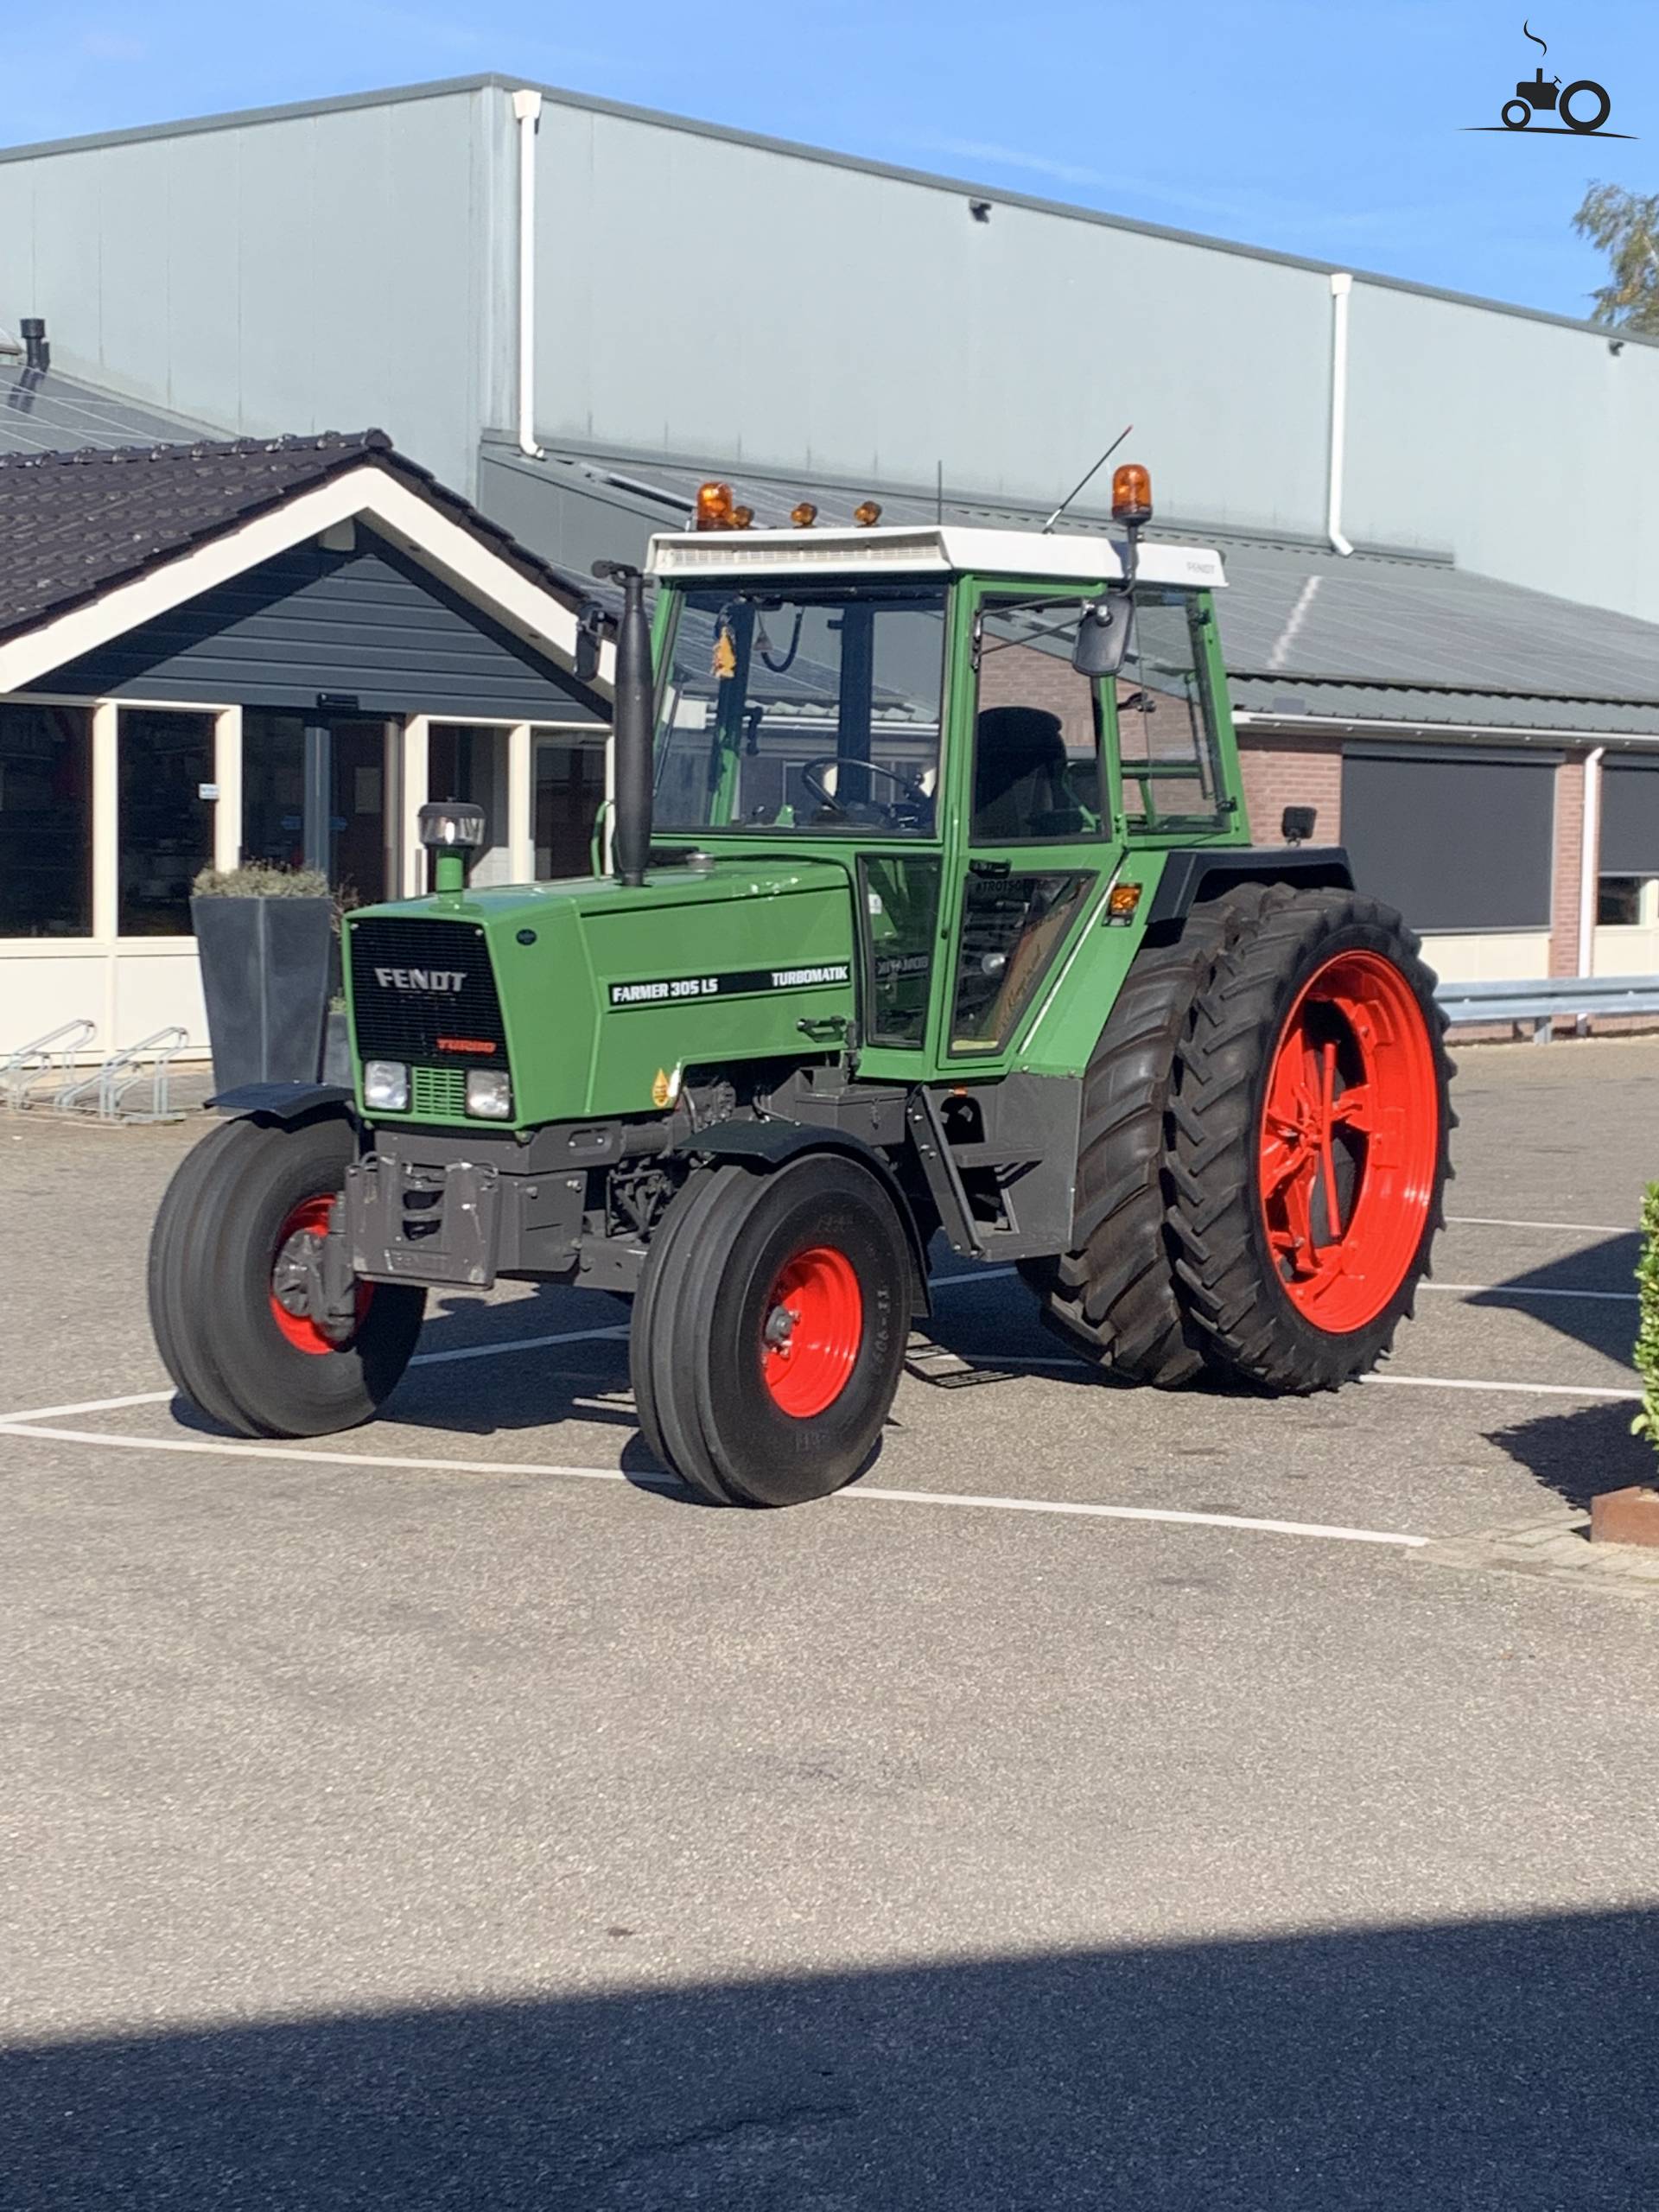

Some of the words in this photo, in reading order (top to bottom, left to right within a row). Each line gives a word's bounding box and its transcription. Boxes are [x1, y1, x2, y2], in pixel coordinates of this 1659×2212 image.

[374, 968, 467, 991] FENDT
[613, 982, 669, 1002] FARMER
[671, 979, 698, 996] 305
[701, 977, 718, 993] LS
[771, 965, 848, 987] TURBOMATIK
